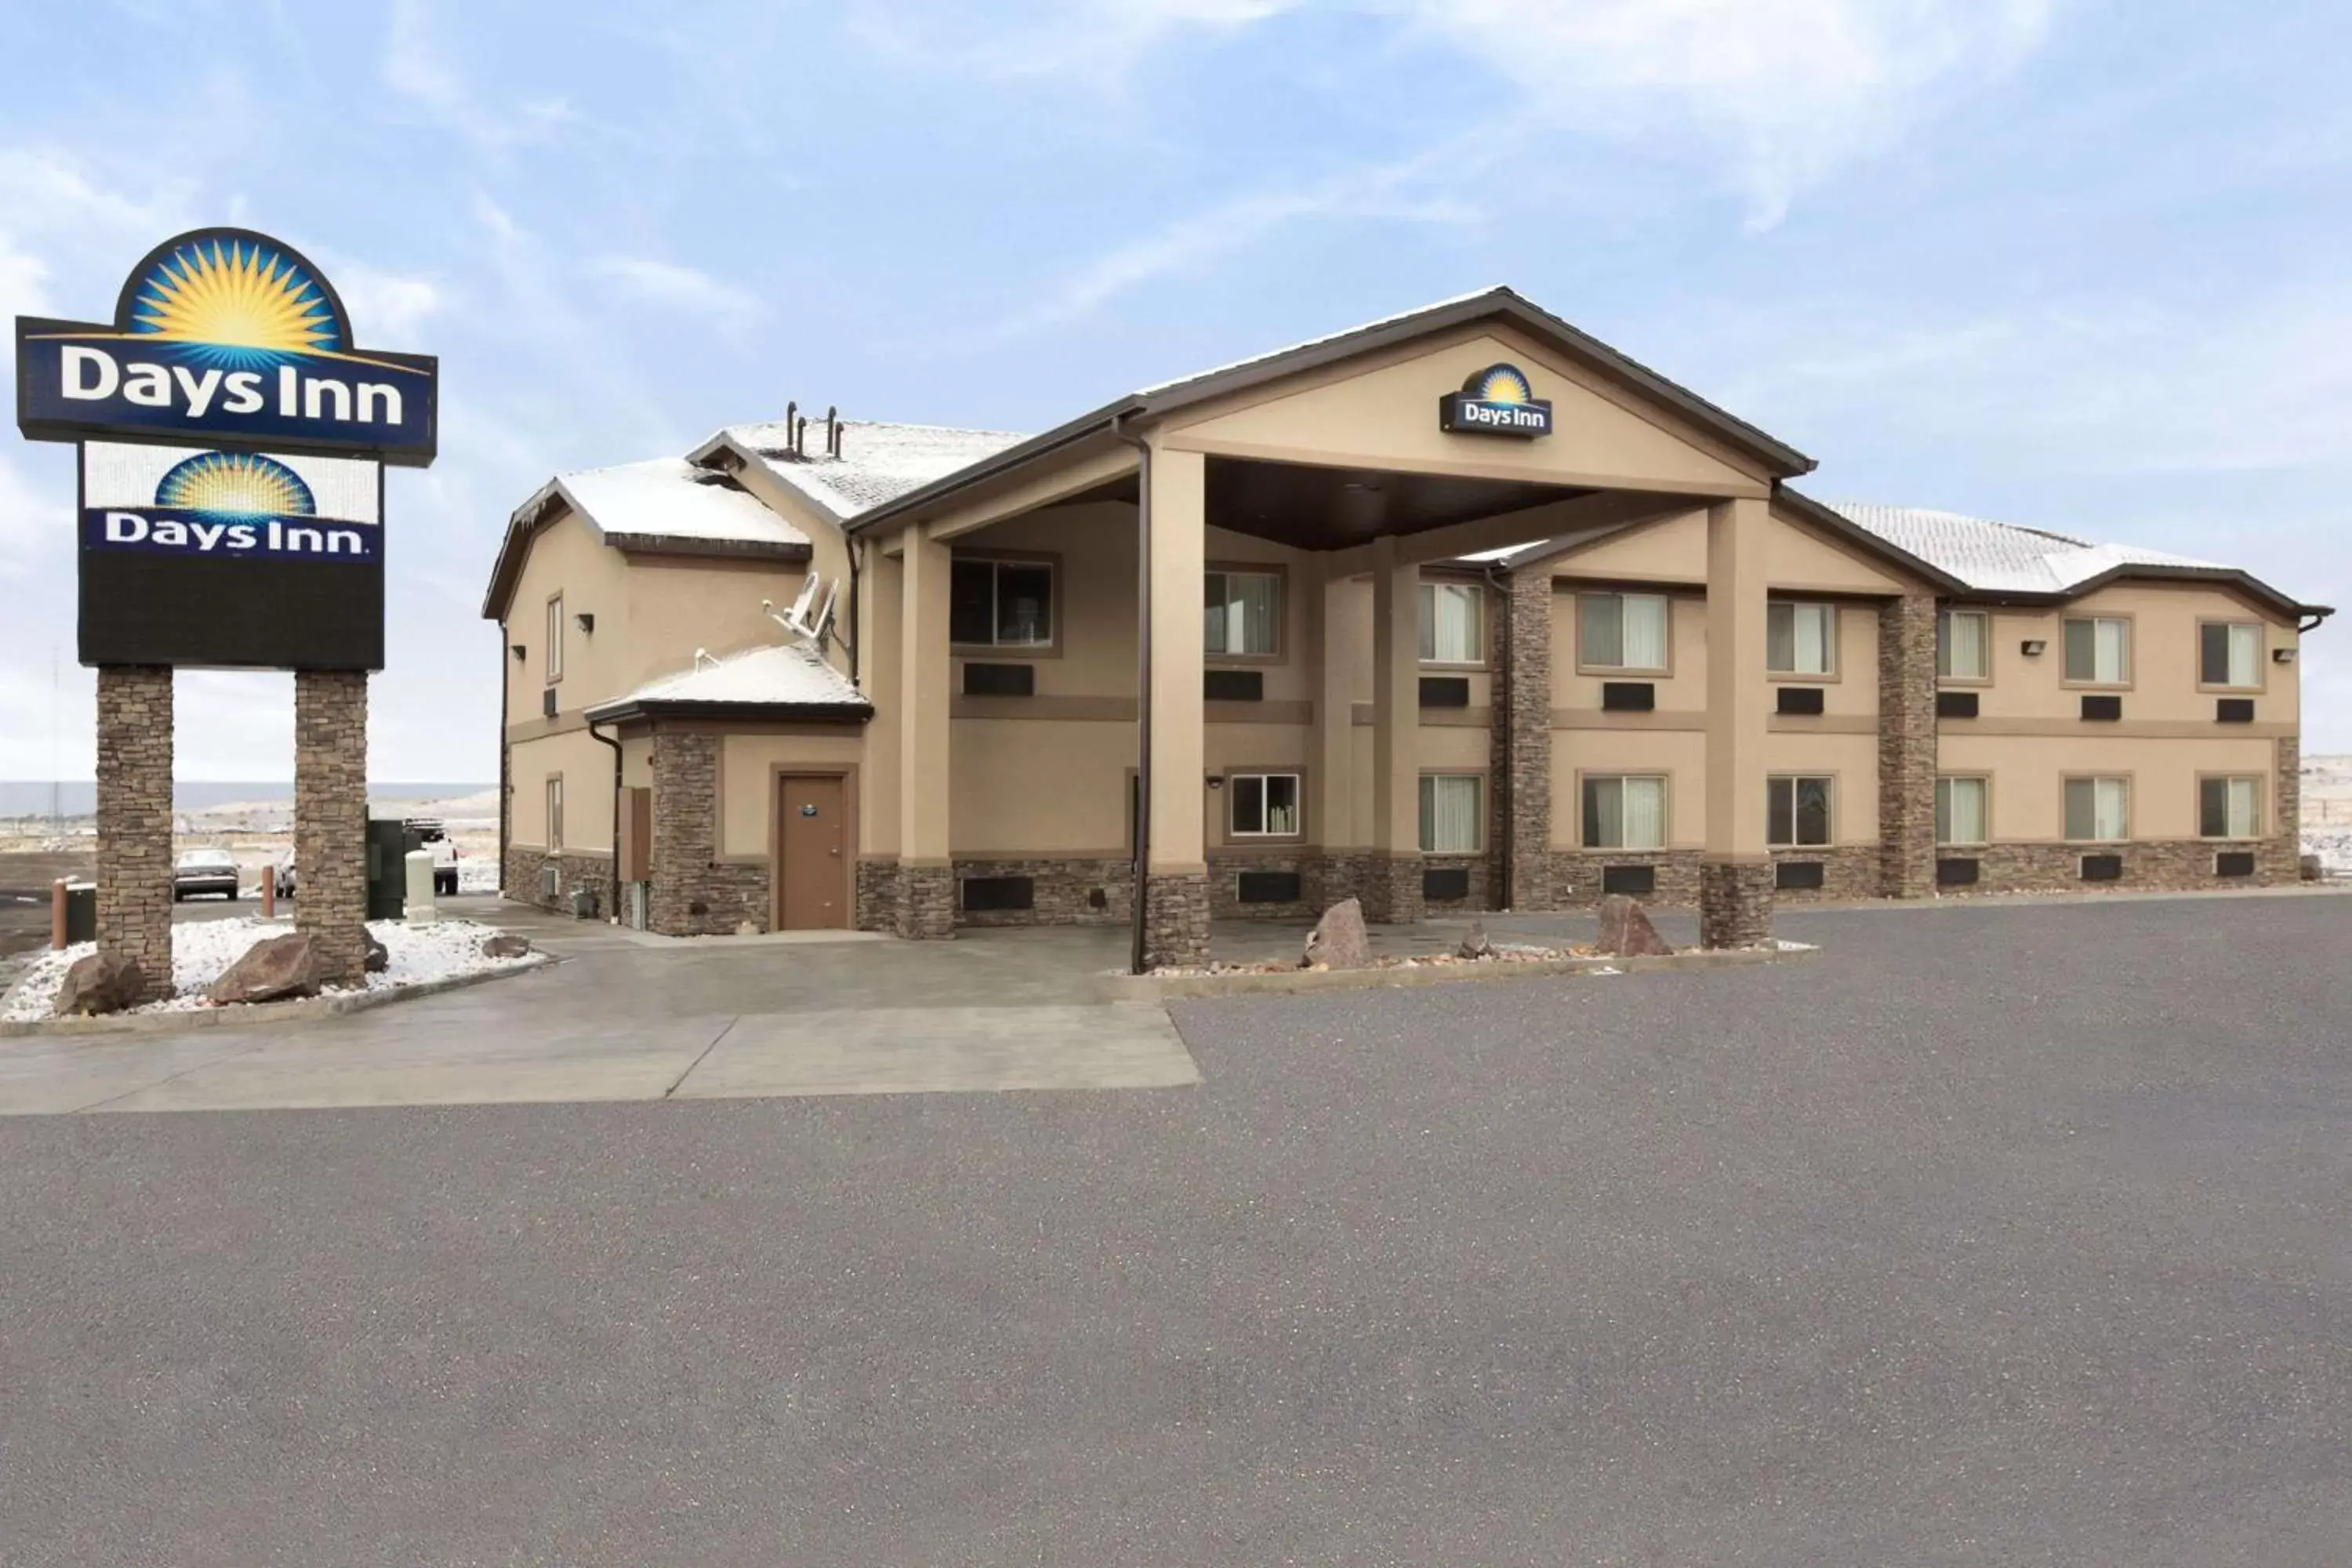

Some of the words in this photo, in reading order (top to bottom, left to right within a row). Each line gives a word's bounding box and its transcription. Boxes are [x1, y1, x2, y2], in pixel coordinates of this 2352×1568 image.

[62, 345, 263, 417] Days
[279, 365, 402, 425] Inn
[1465, 402, 1512, 426] Days
[1513, 408, 1545, 427] Inn
[106, 512, 256, 551] Days
